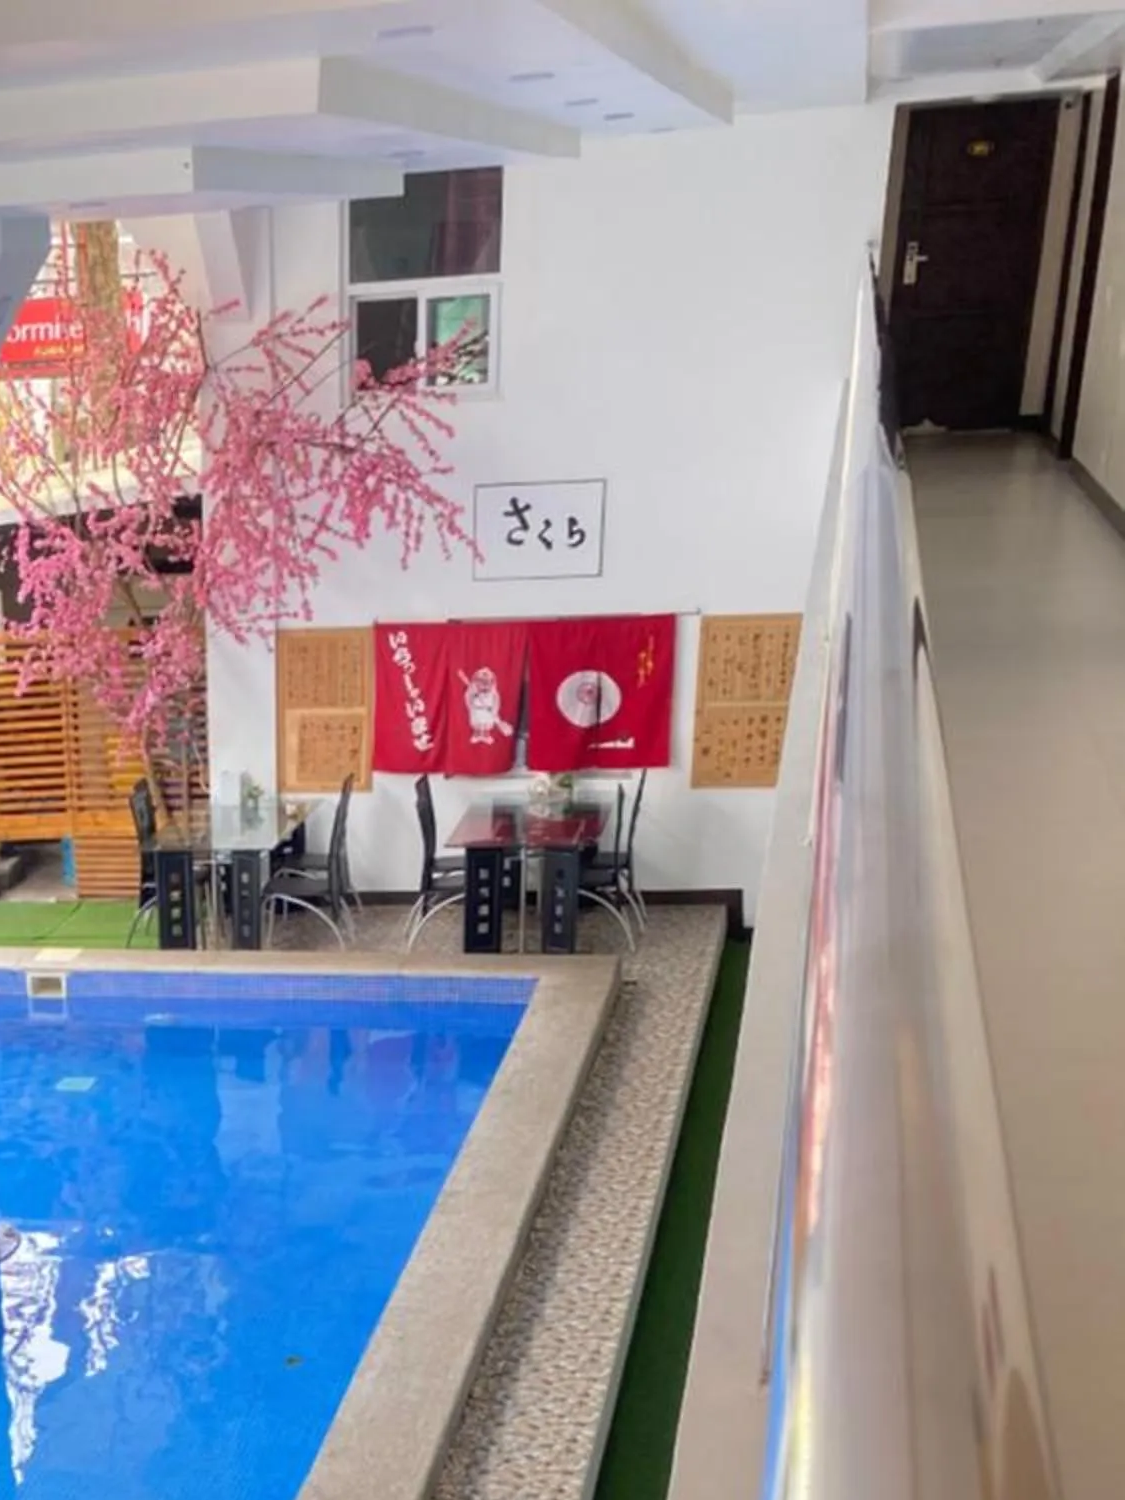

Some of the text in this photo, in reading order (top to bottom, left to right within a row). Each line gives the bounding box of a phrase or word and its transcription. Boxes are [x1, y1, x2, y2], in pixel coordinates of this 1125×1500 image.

[502, 496, 586, 551] さくら
[388, 630, 434, 752] いらっしゃいませ
